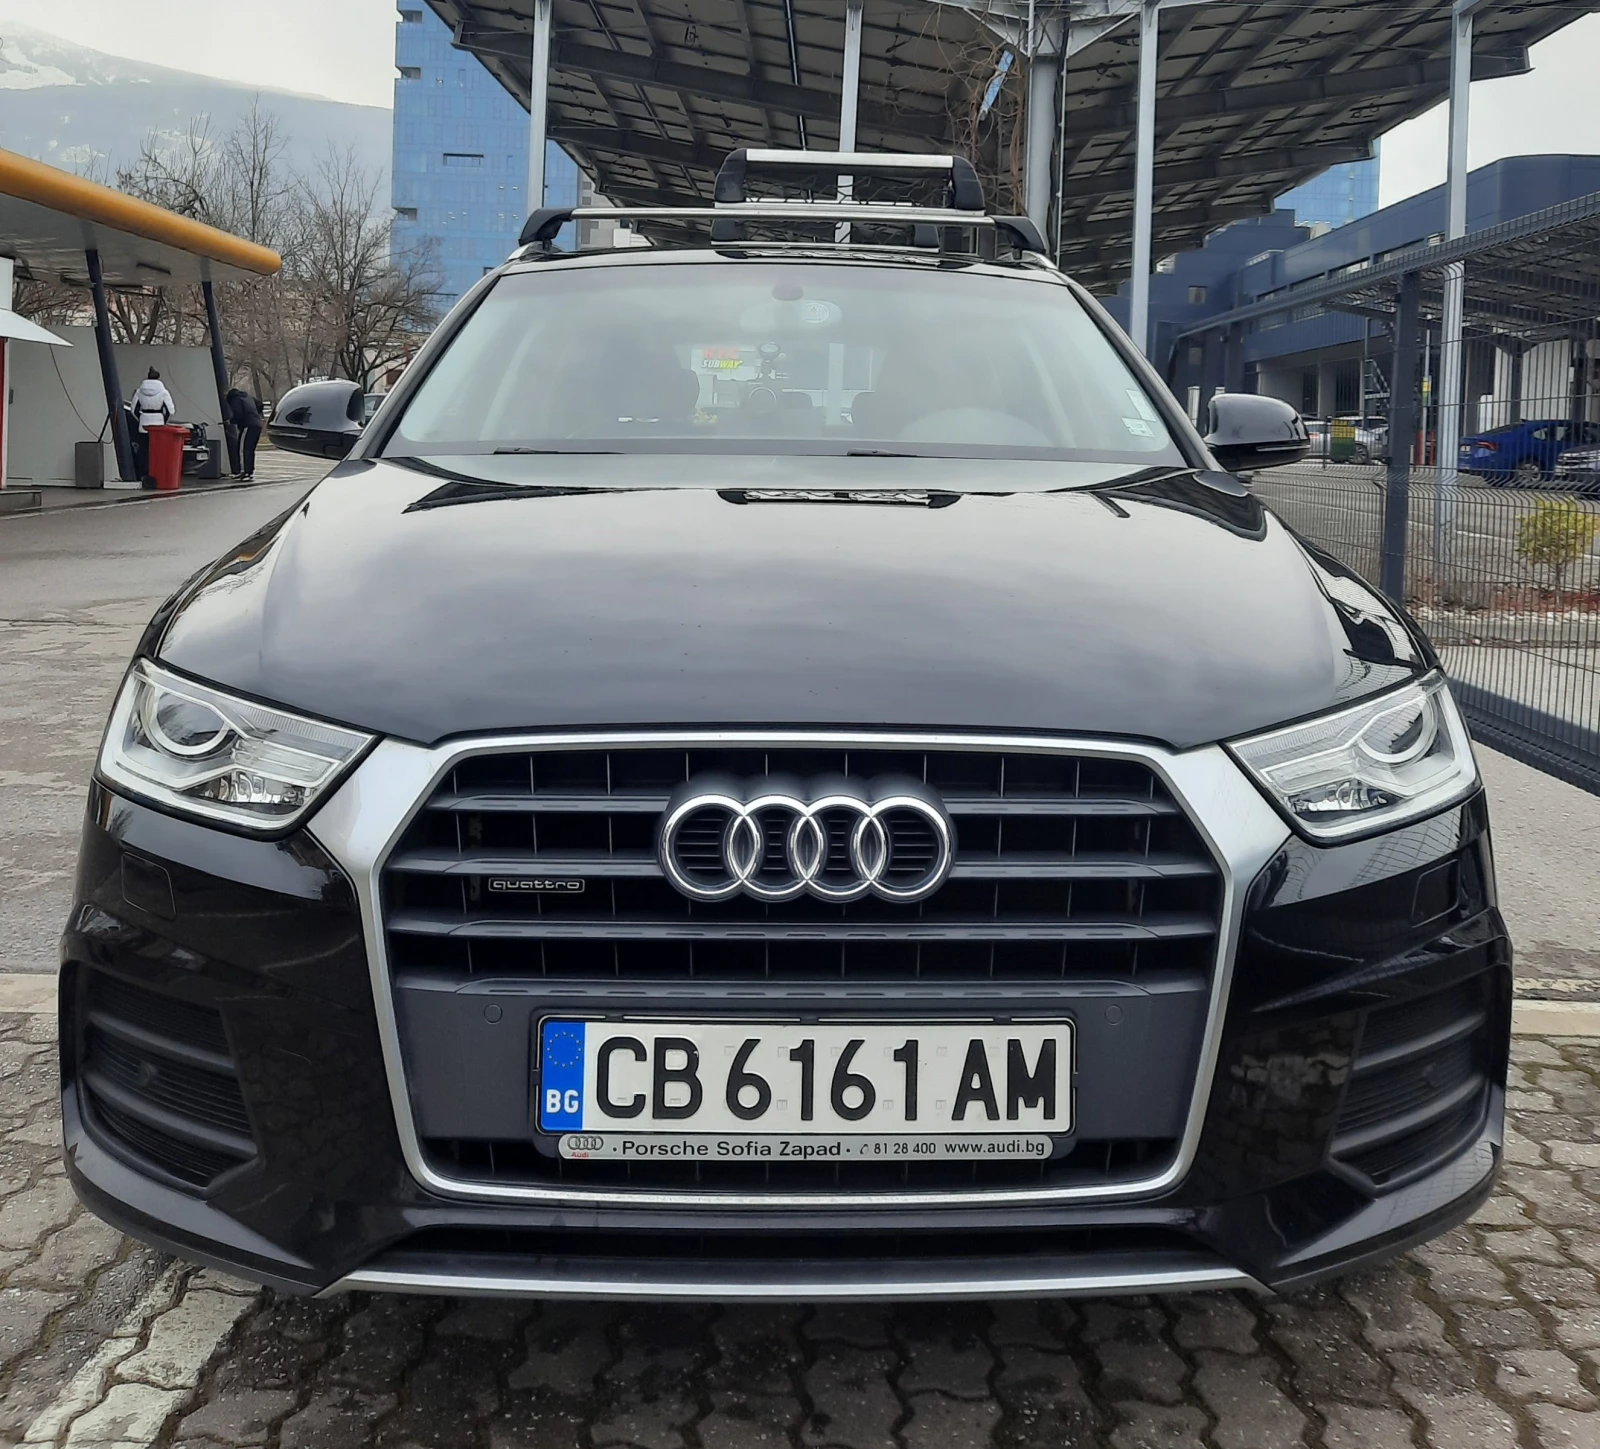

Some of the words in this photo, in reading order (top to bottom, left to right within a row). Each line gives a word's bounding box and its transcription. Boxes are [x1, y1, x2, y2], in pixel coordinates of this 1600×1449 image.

[701, 359, 743, 369] SUBWAY
[493, 880, 580, 890] quattro
[596, 1036, 703, 1119] CB
[726, 1038, 919, 1121] 6161
[951, 1038, 1056, 1120] AM
[546, 1089, 579, 1114] BG
[622, 1140, 709, 1156] Porsche
[716, 1140, 772, 1156] Sofia
[779, 1141, 841, 1159] Zapad
[873, 1142, 890, 1155] 81
[893, 1142, 911, 1155] 28
[912, 1142, 937, 1155] 400
[944, 1139, 1045, 1155] www.audi.bg
